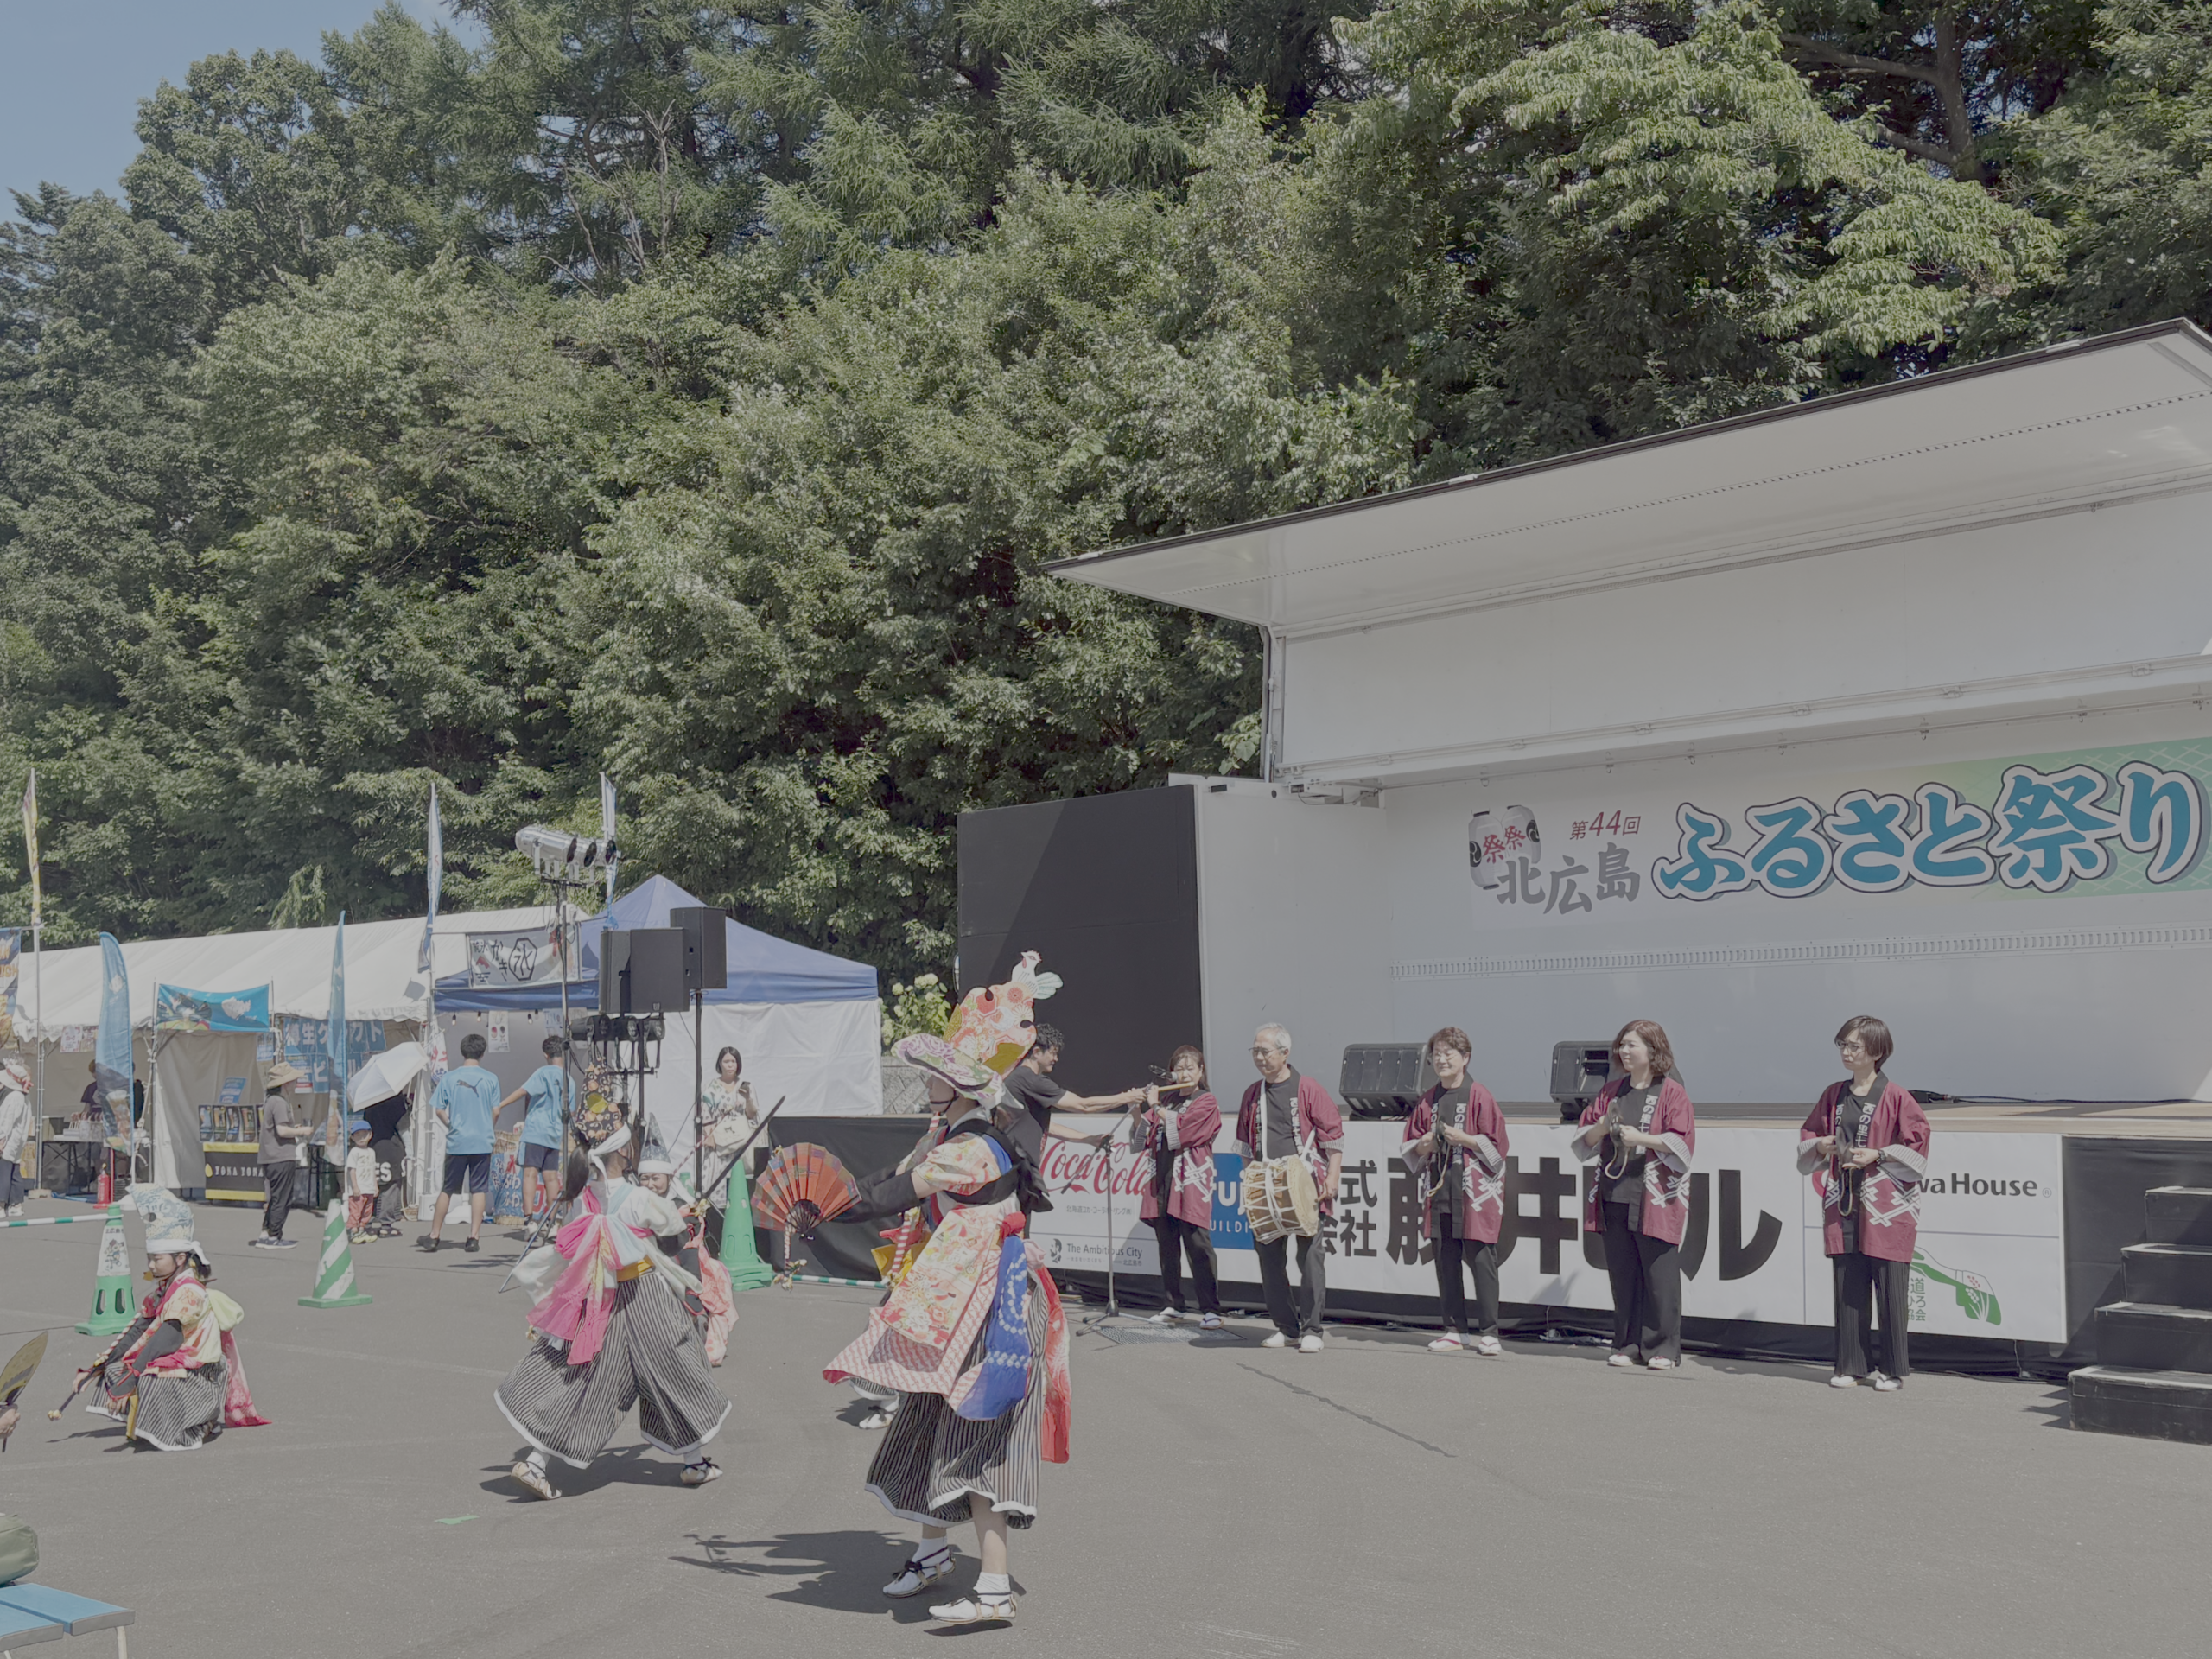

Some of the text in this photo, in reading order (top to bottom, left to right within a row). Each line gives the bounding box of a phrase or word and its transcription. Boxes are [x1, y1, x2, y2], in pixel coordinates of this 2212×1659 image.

[1569, 810, 1642, 841] 第44回
[1657, 766, 2196, 896] ふるさと祭り
[1483, 834, 1506, 864] 祭
[1497, 842, 1641, 915] 北広島
[1950, 1173, 2038, 1197] House
[1066, 1243, 1082, 1254] The
[1126, 1246, 1143, 1260] City
